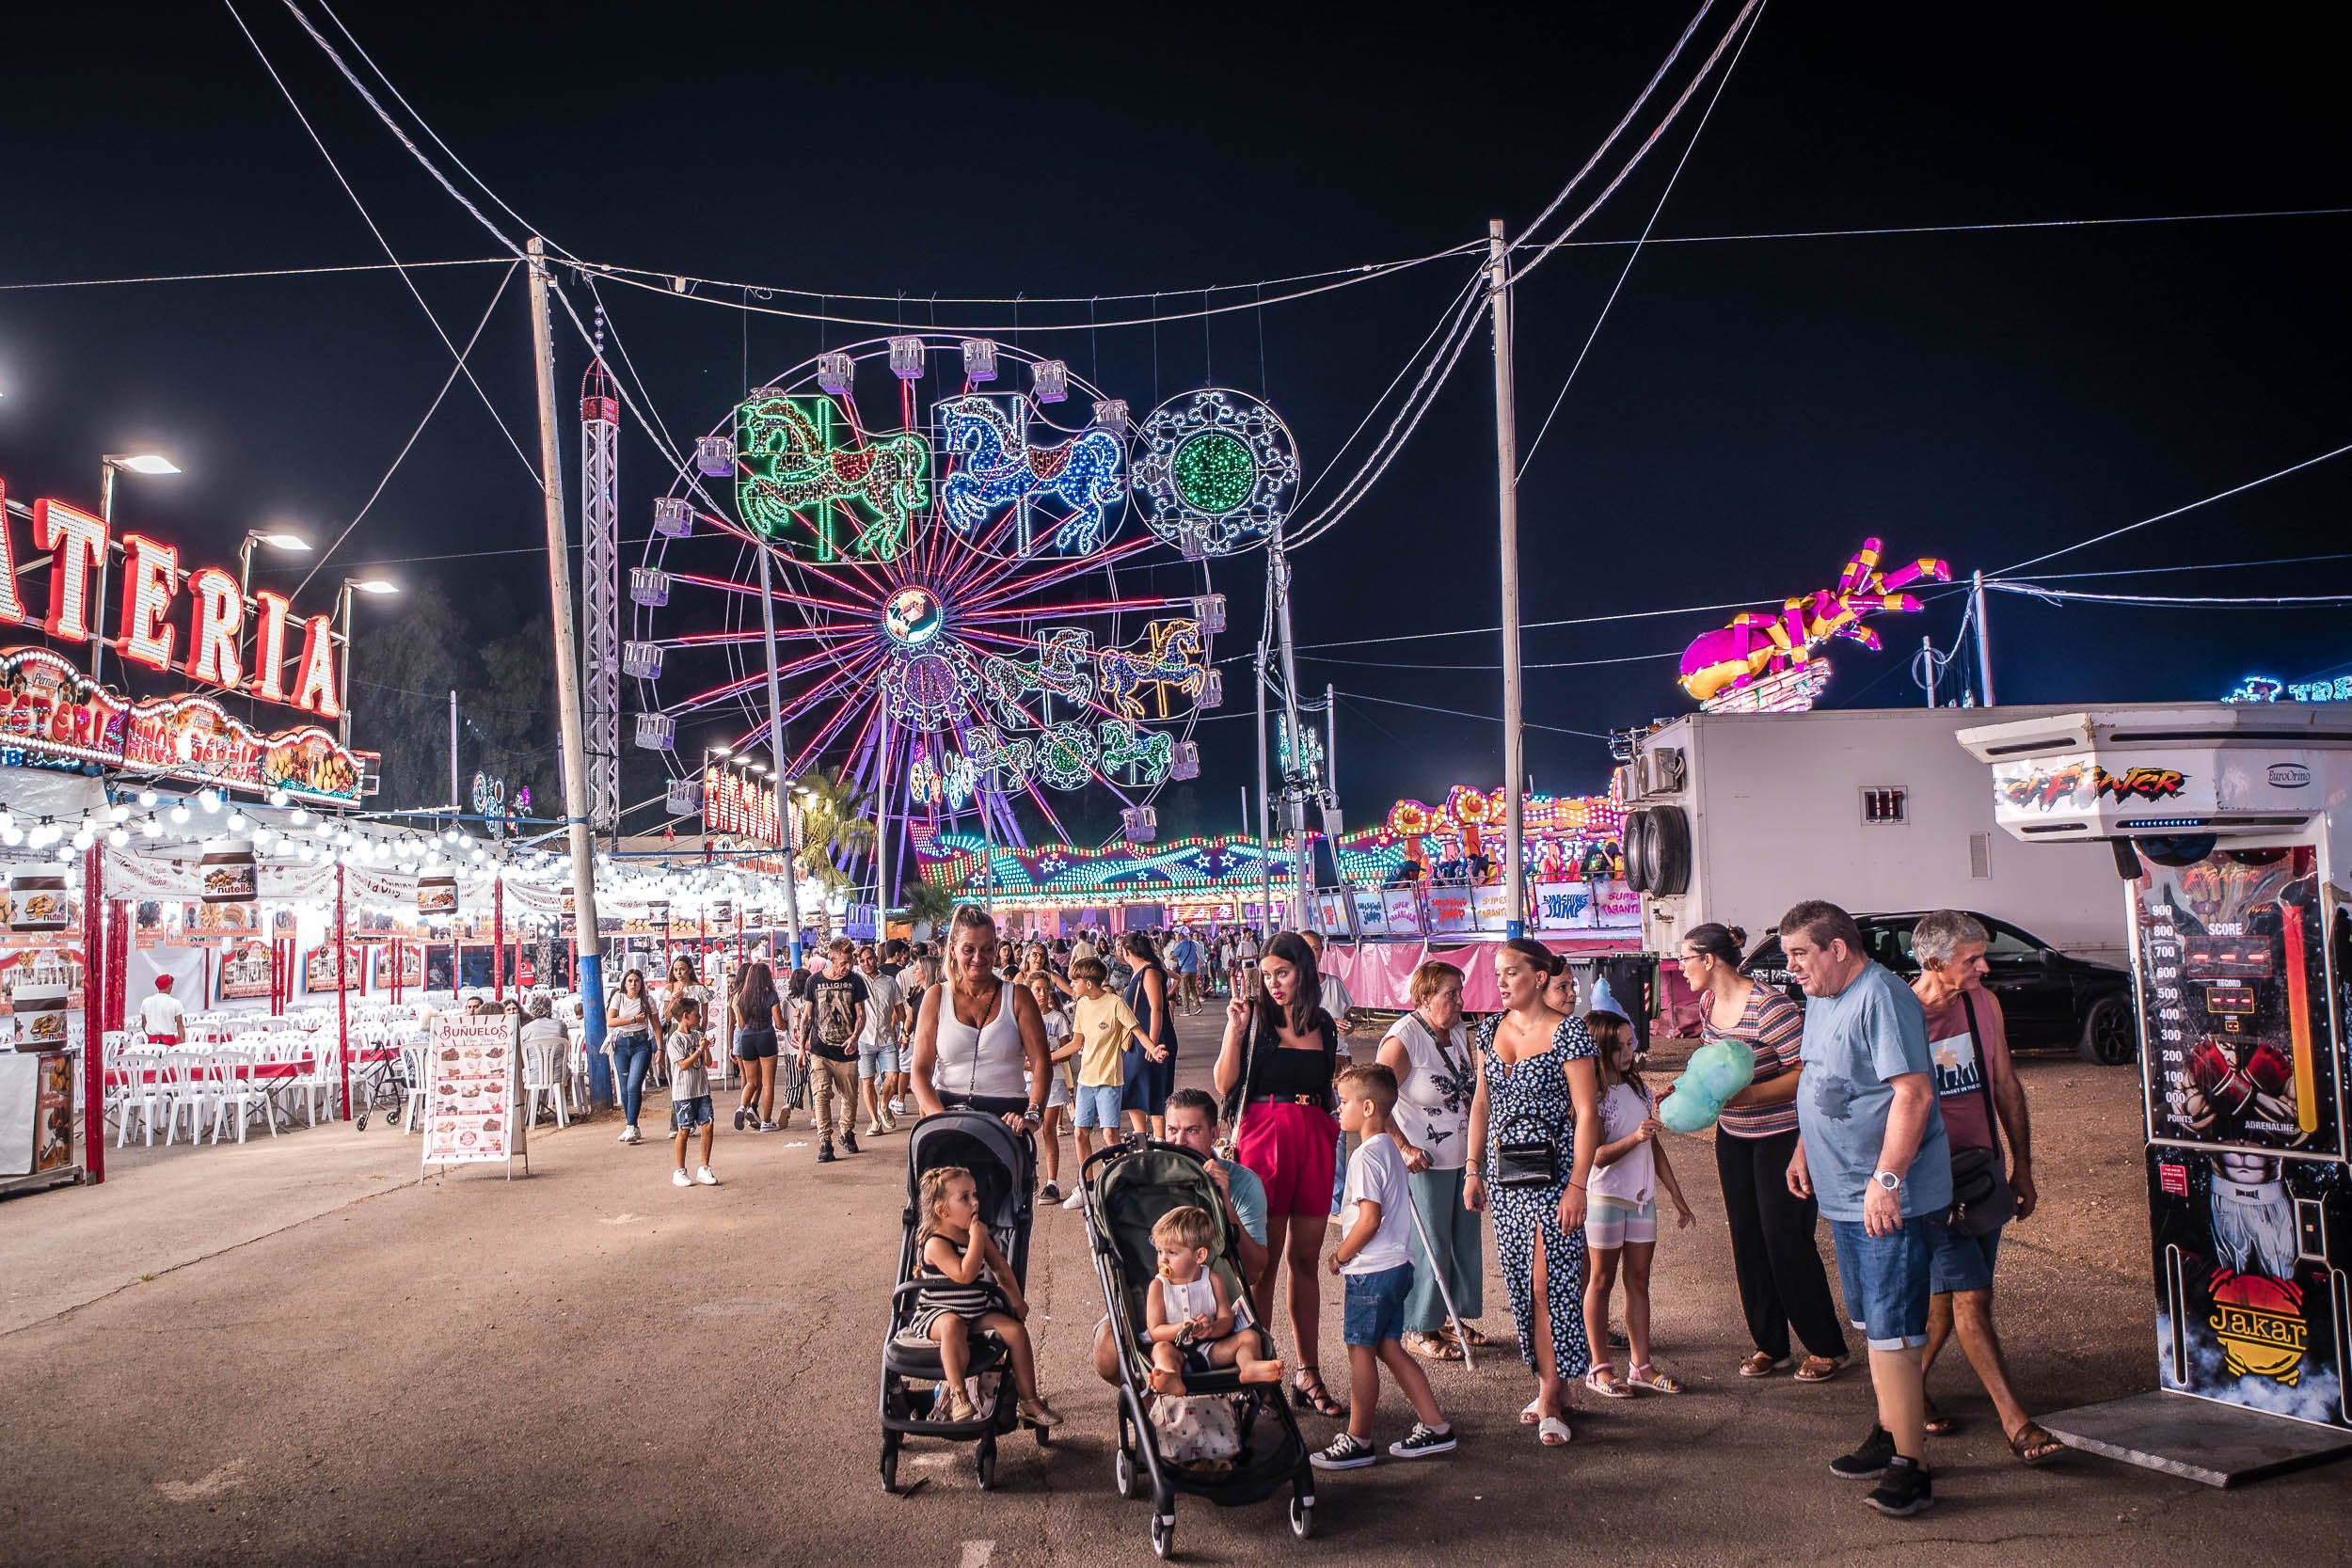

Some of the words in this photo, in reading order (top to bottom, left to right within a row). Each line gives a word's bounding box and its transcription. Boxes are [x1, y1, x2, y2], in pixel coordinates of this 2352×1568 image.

[217, 883, 253, 895] nutella
[1542, 894, 1590, 906] SMASHING
[1545, 902, 1587, 919] JUMP
[2153, 905, 2172, 916] 900
[2153, 926, 2174, 937] 800
[2208, 923, 2244, 936] SCORE
[2155, 946, 2175, 958] 700
[2156, 967, 2176, 978] 600
[2158, 988, 2178, 999] 500
[2160, 1008, 2180, 1020] 400
[440, 1025, 508, 1040] BUÑUELOS
[2161, 1029, 2182, 1041] 300
[2162, 1050, 2183, 1062] 200
[2164, 1070, 2185, 1083] 100
[2166, 1092, 2186, 1104] 000
[2167, 1113, 2194, 1124] POINTS
[2244, 1120, 2296, 1133] ADRENALINE
[2208, 1306, 2308, 1349] Jakar
